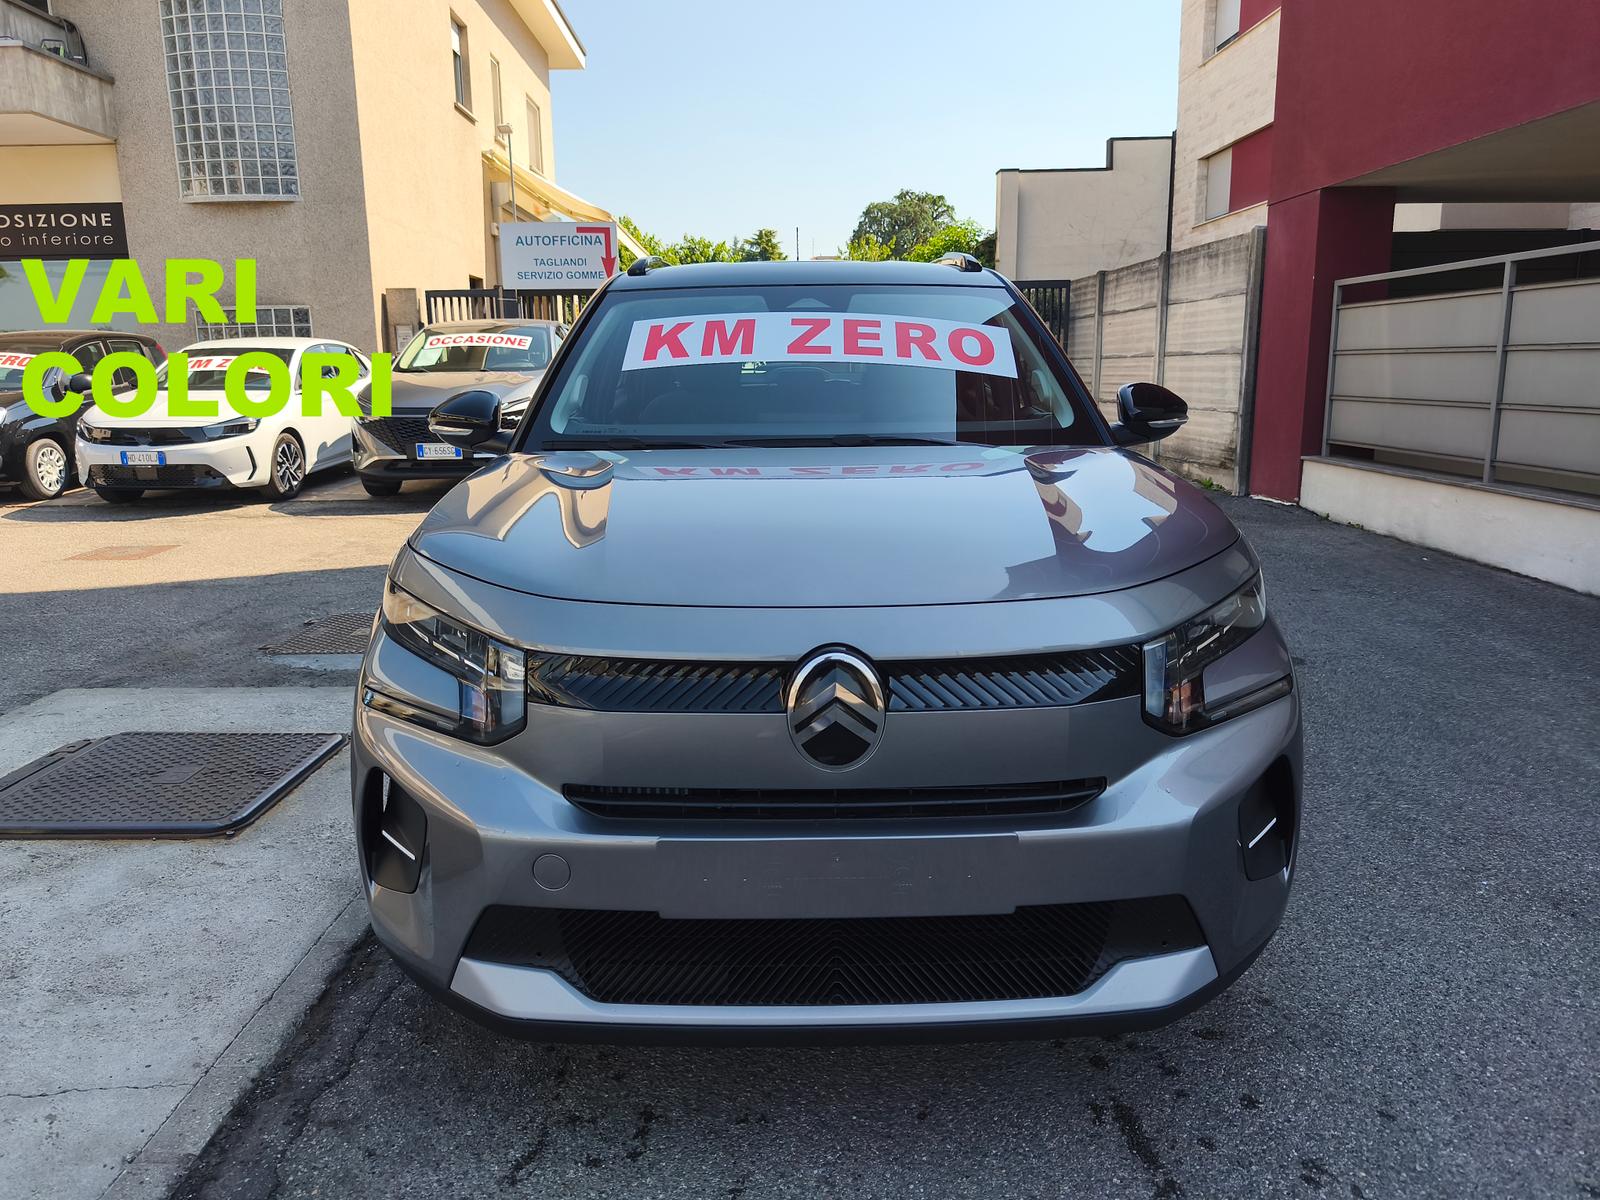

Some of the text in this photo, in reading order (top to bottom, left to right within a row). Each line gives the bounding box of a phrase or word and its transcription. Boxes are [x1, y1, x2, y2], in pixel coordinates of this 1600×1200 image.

[21, 232, 114, 247] inferiore
[515, 235, 603, 247] AUTOFFICINA
[533, 257, 588, 267] TAGLIANDI
[517, 271, 604, 280] SERVIZIO GOMME
[429, 335, 528, 348] OCCASIONE
[642, 318, 996, 367] KM ZERO
